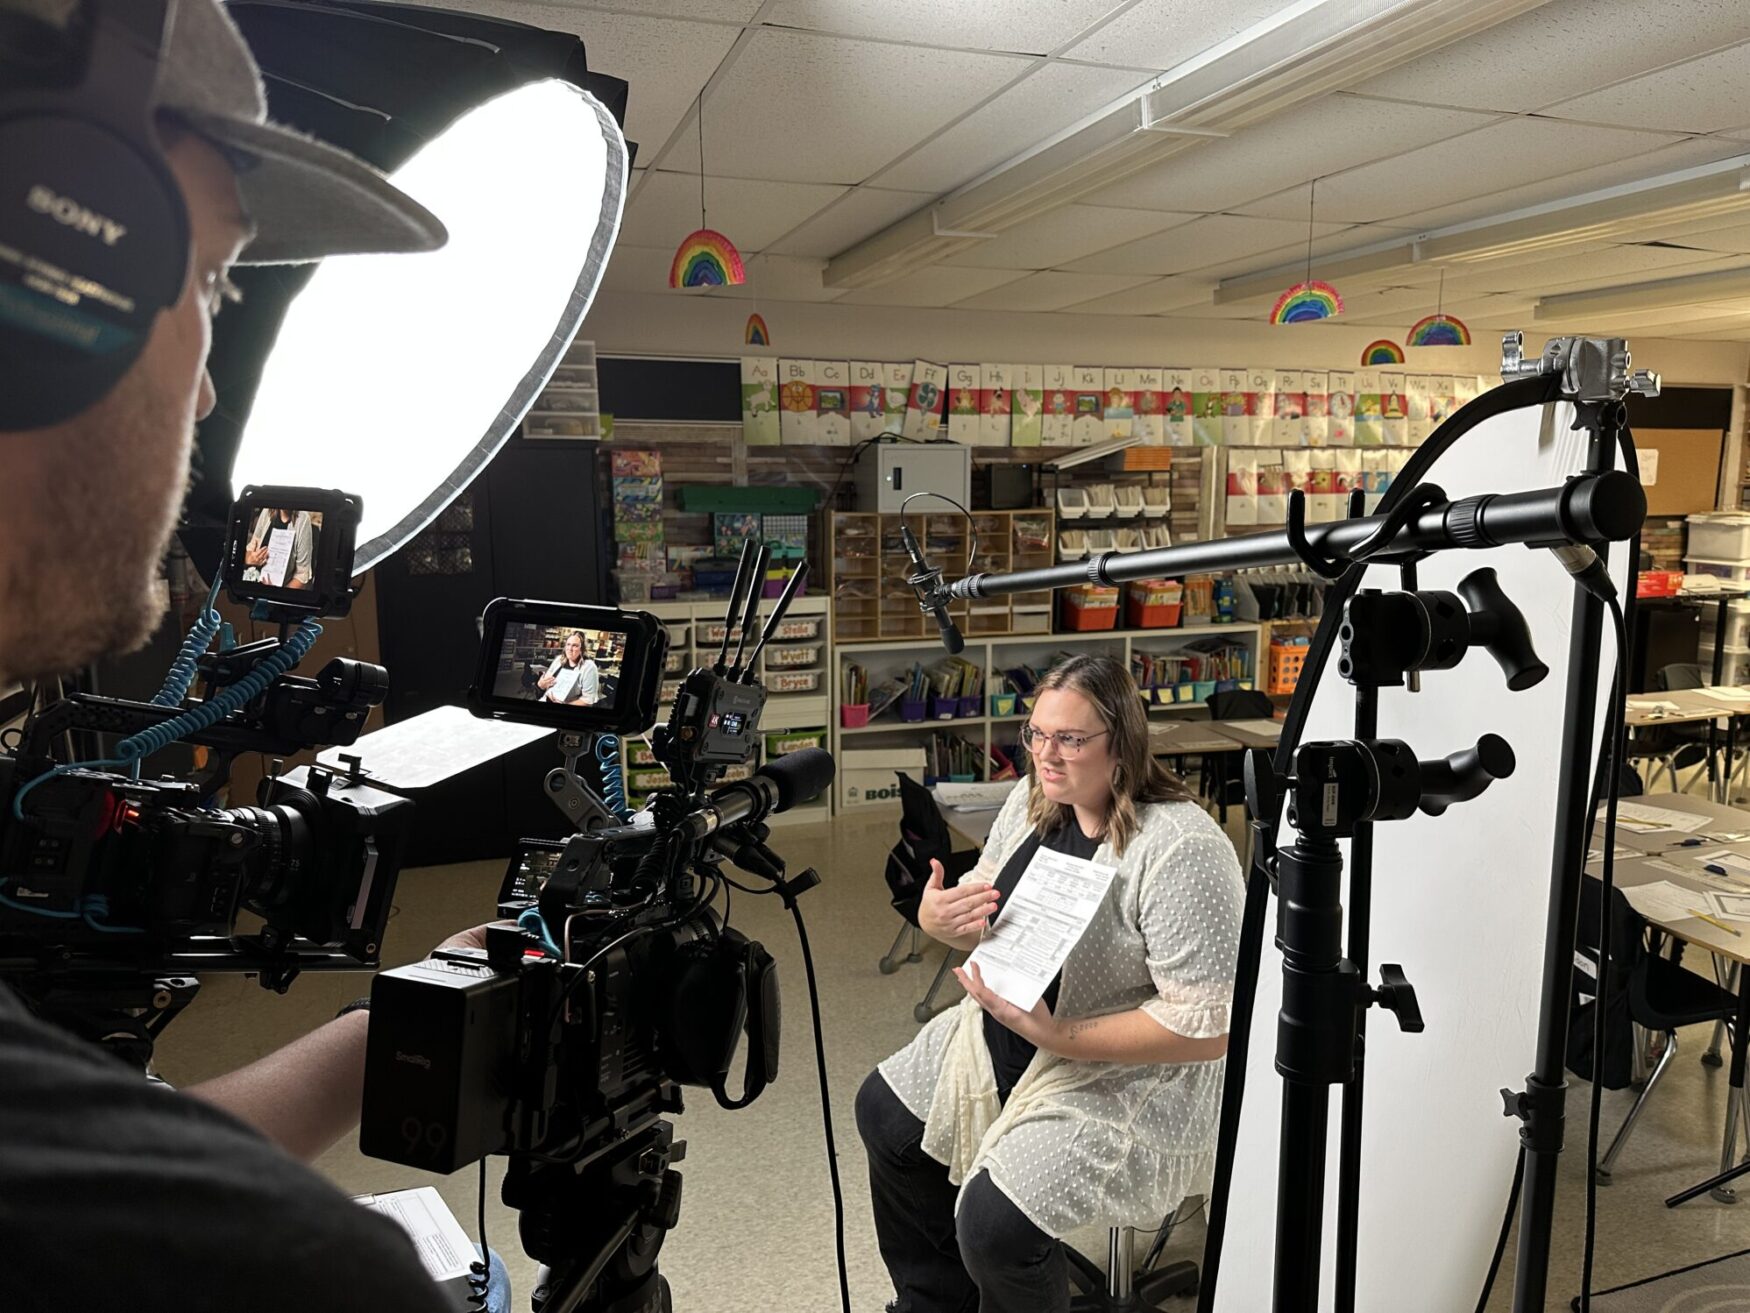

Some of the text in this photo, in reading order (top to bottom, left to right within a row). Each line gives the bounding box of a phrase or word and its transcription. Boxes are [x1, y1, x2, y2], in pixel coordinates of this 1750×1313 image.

[27, 184, 127, 246] SONY
[752, 365, 768, 377] Aa
[789, 365, 805, 377] Bb
[823, 367, 840, 379] Cc
[860, 367, 875, 380] Dd
[957, 370, 973, 387] Gg
[1053, 371, 1065, 387] Jj
[402, 1117, 446, 1159] 99
